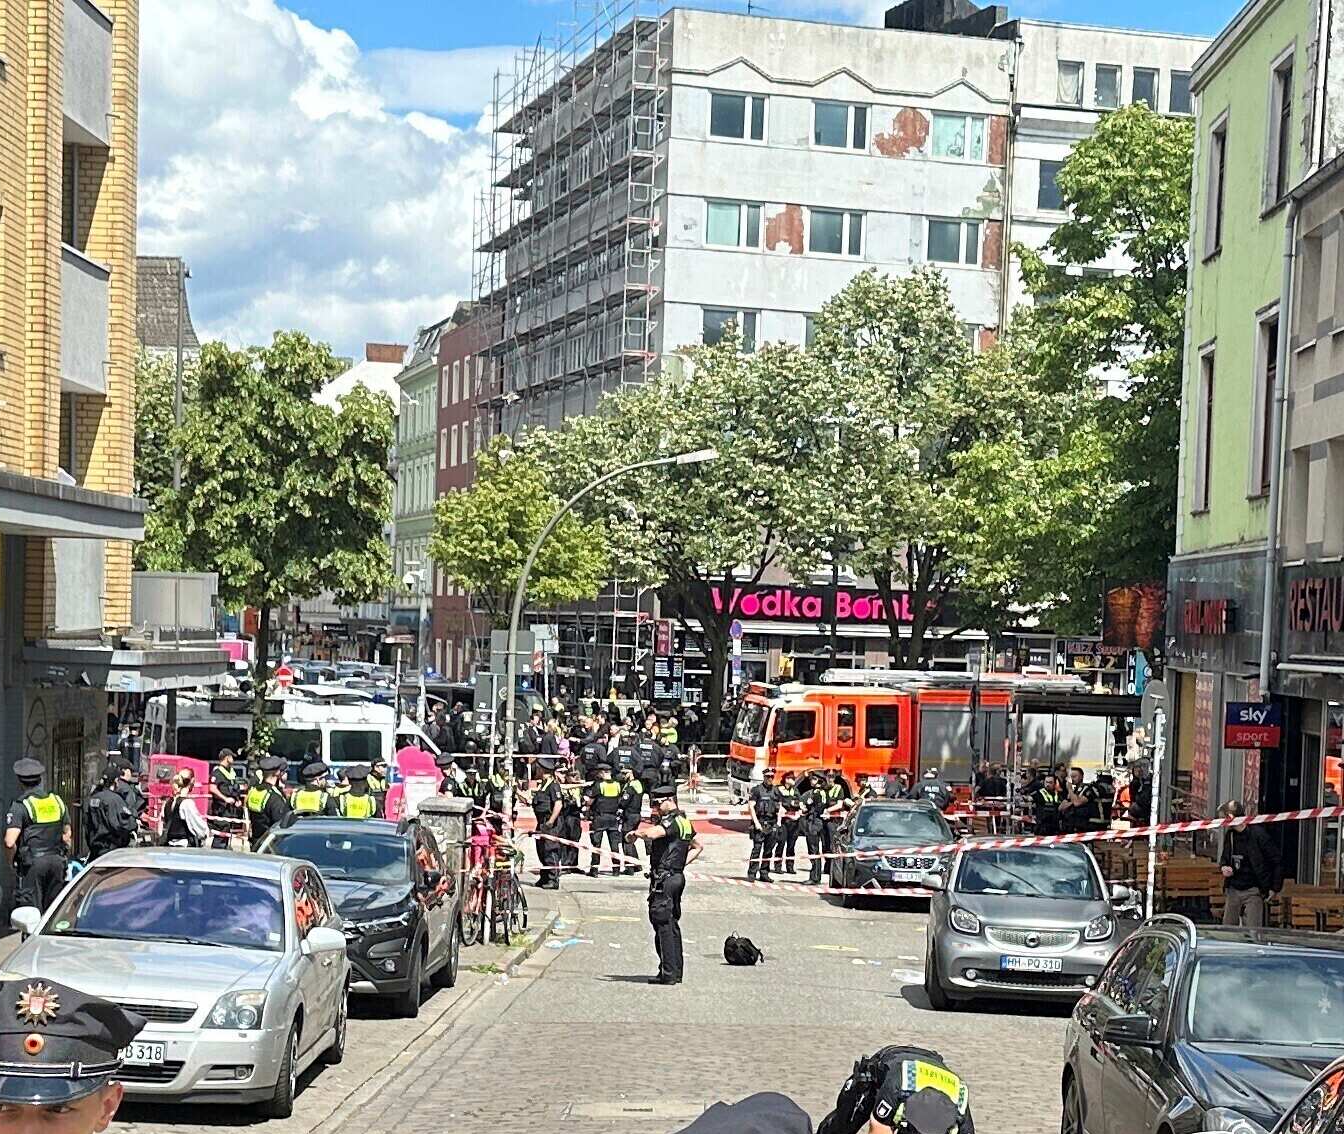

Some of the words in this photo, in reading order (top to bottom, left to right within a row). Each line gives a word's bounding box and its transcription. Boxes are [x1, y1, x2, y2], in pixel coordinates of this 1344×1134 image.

[1240, 707, 1268, 725] sky
[1236, 731, 1270, 742] sport
[137, 1043, 162, 1060] 318
